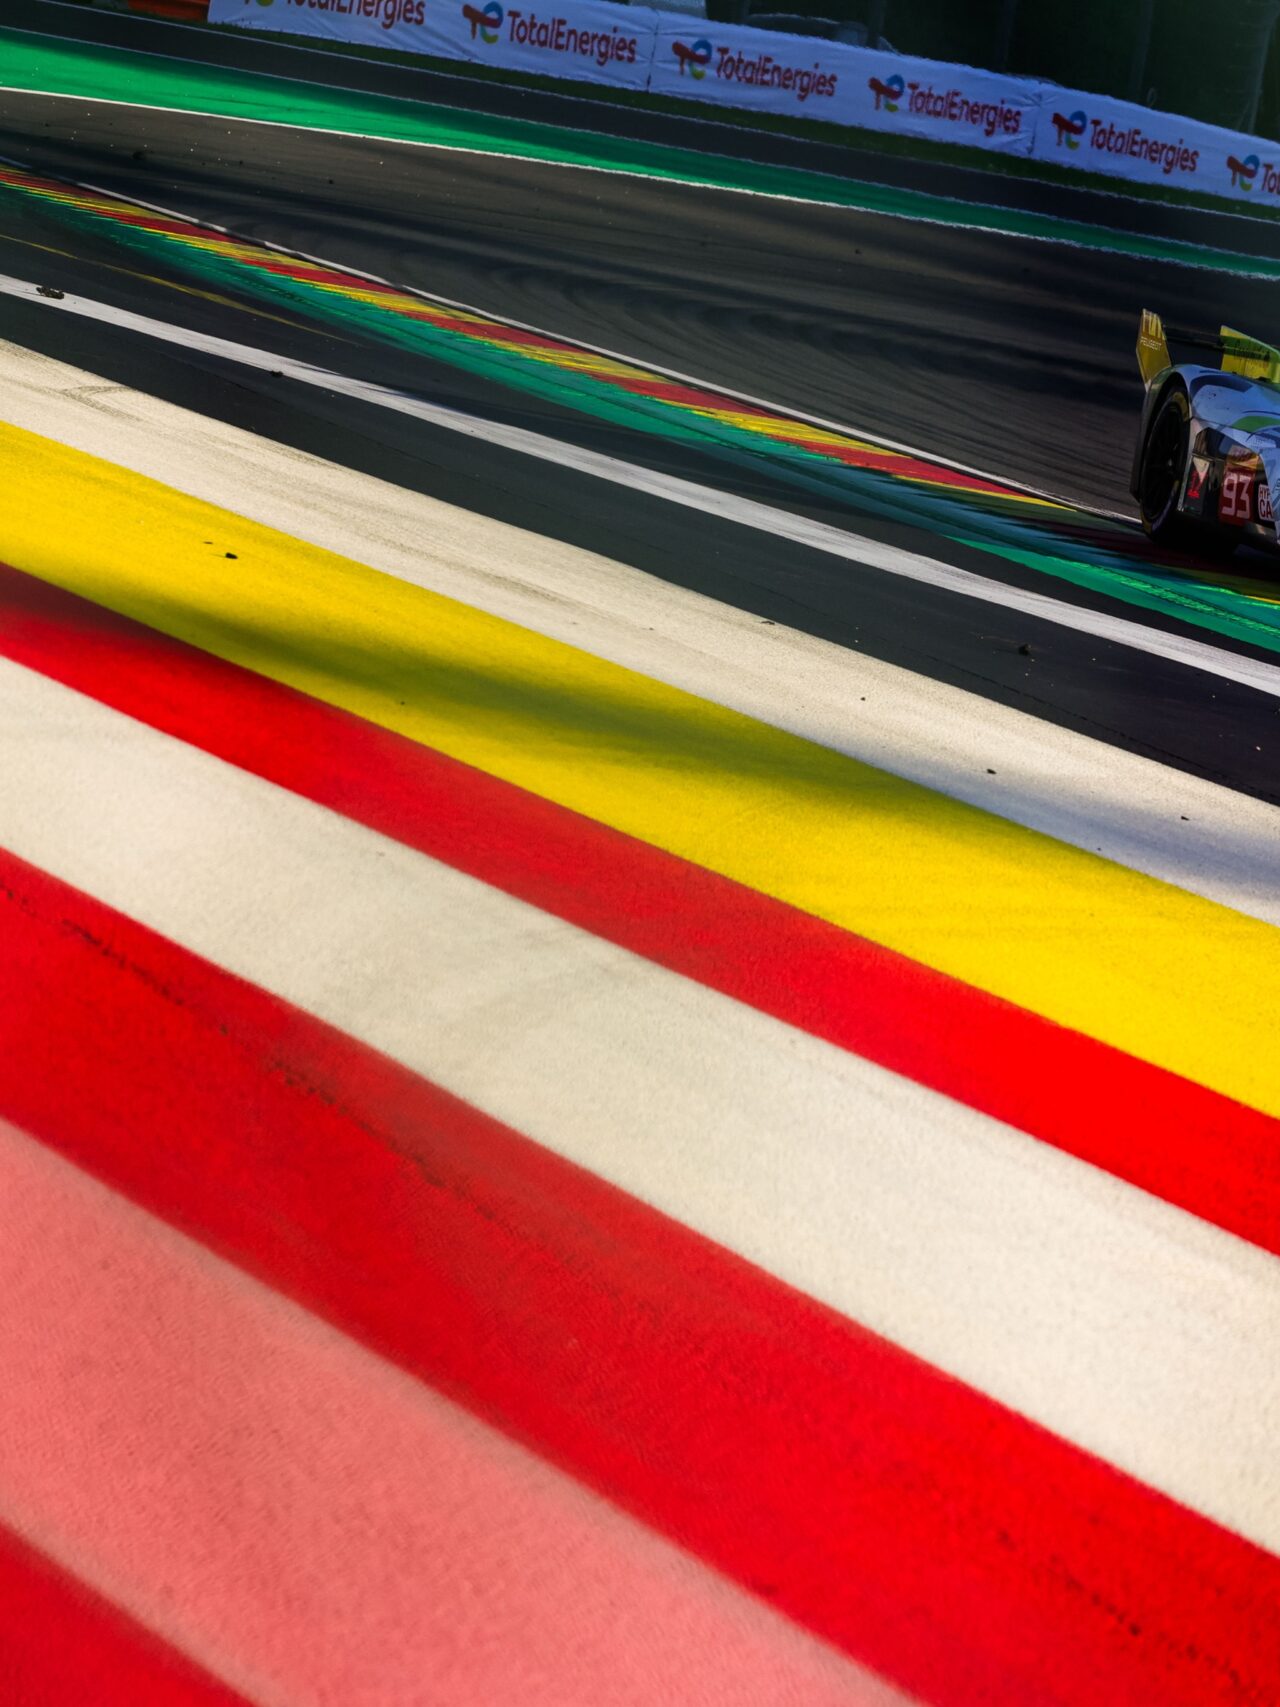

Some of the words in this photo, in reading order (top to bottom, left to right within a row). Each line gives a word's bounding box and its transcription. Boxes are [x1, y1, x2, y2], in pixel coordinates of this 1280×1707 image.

[286, 0, 425, 29] nergies
[507, 11, 636, 65] TotalEnergies
[714, 47, 837, 100] TotalEnergies
[907, 83, 1021, 136] TotalEnergies
[1089, 119, 1200, 174] TotalEnergies
[1221, 472, 1251, 520] 93
